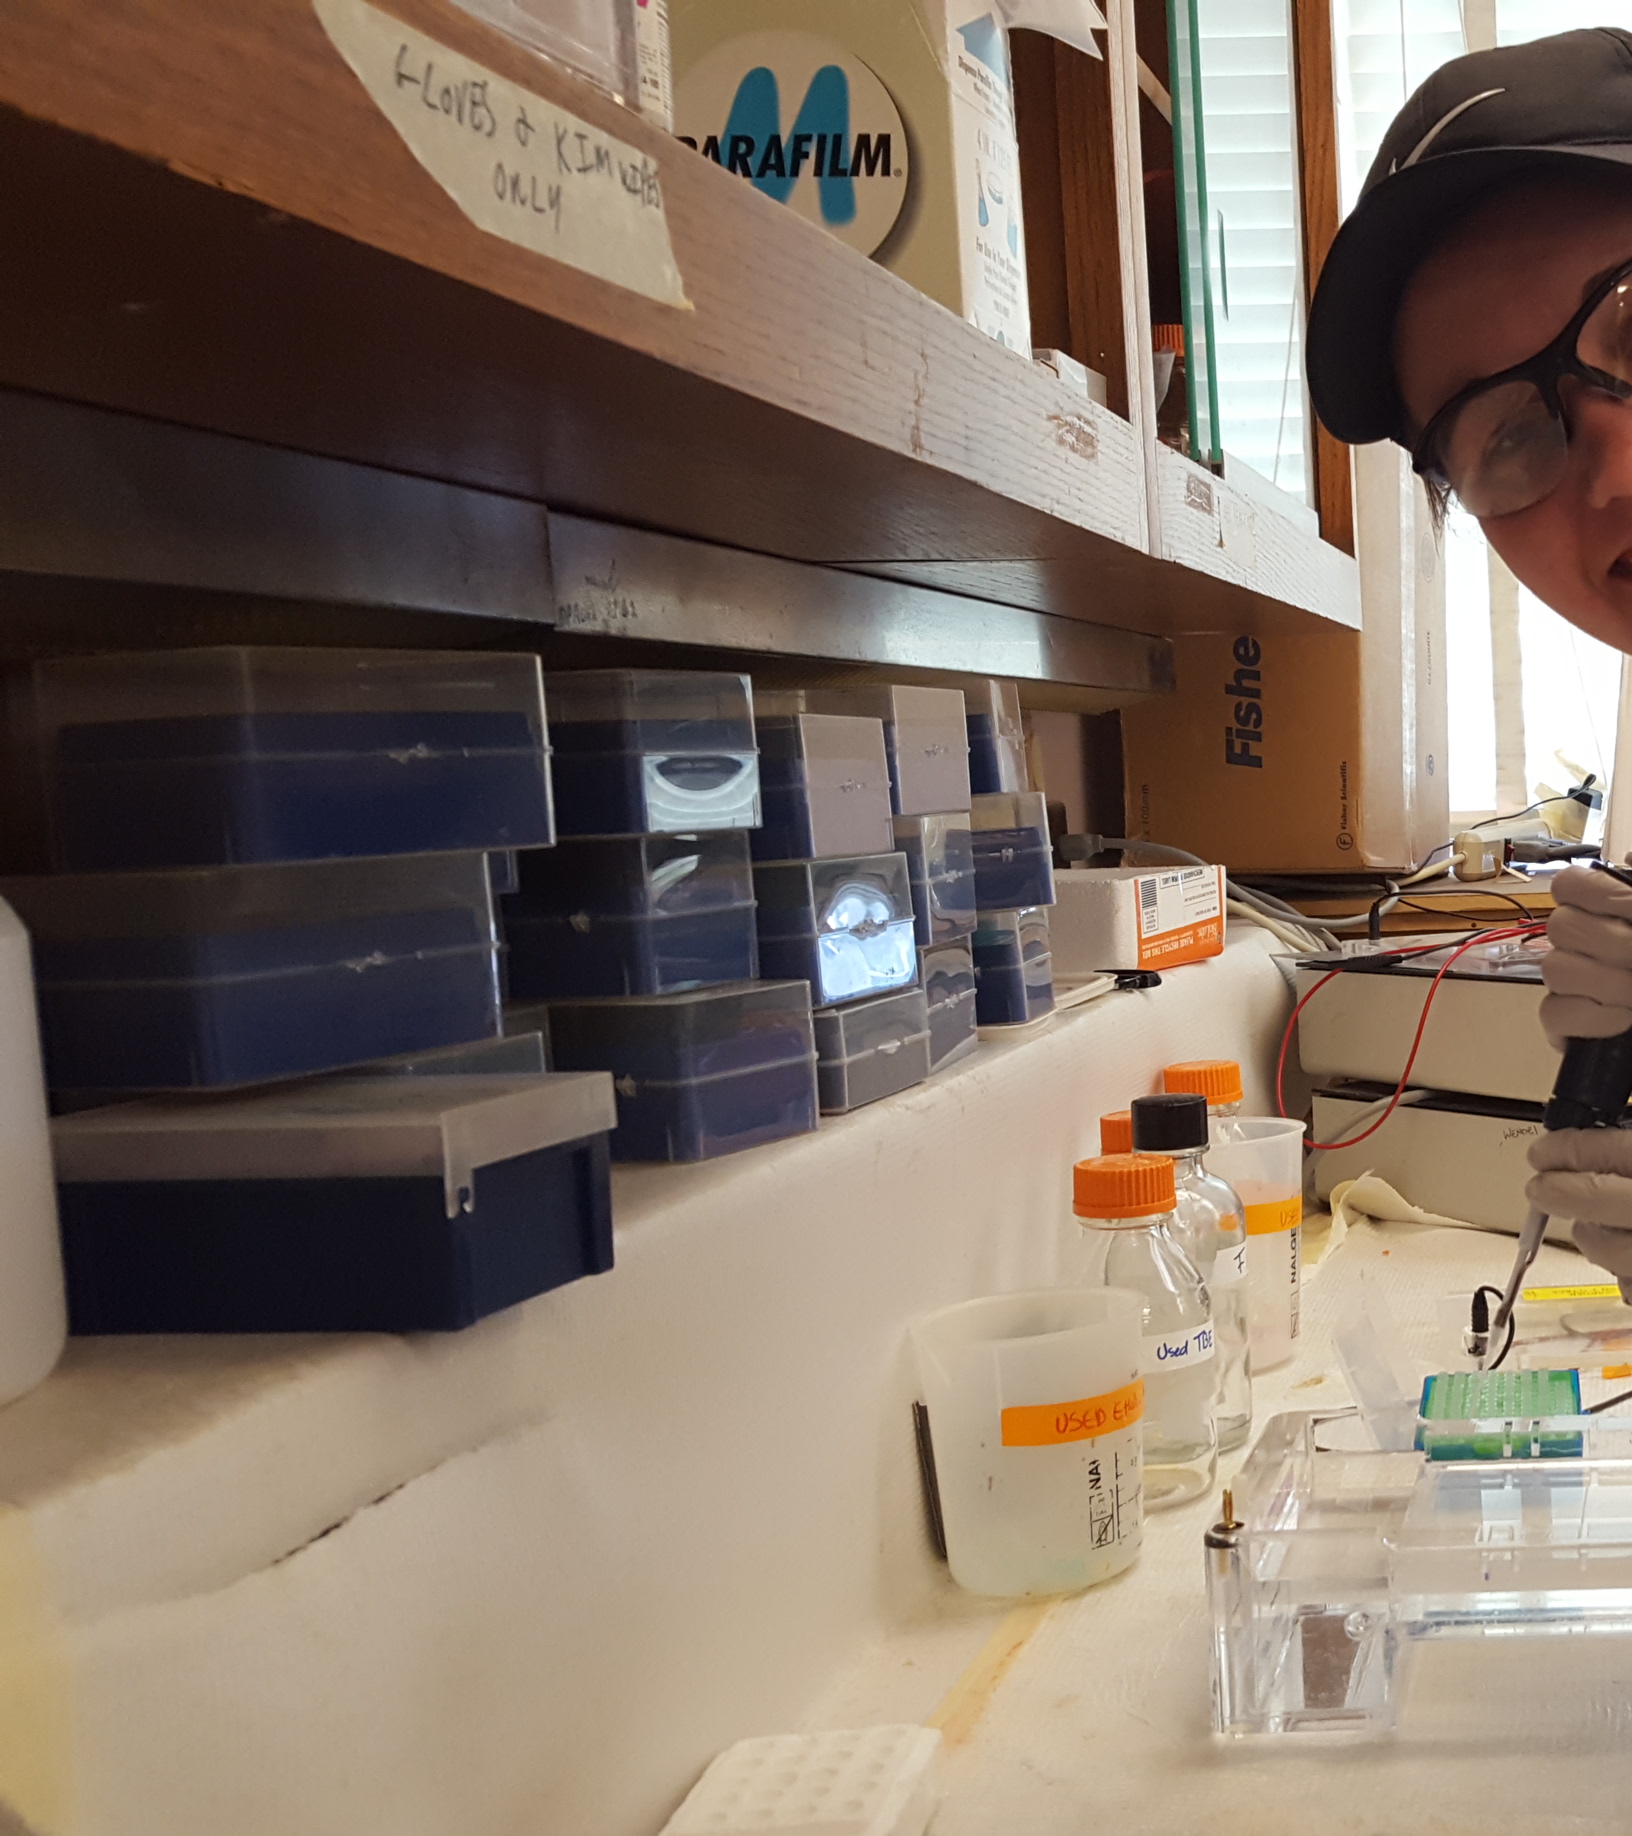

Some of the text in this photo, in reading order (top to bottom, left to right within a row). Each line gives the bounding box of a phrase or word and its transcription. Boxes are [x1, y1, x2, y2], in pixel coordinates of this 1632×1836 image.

[493, 161, 562, 234] ONLY
[1225, 634, 1264, 768] Fishe
[1157, 1340, 1189, 1361] Used
[1055, 1408, 1107, 1434] USED
